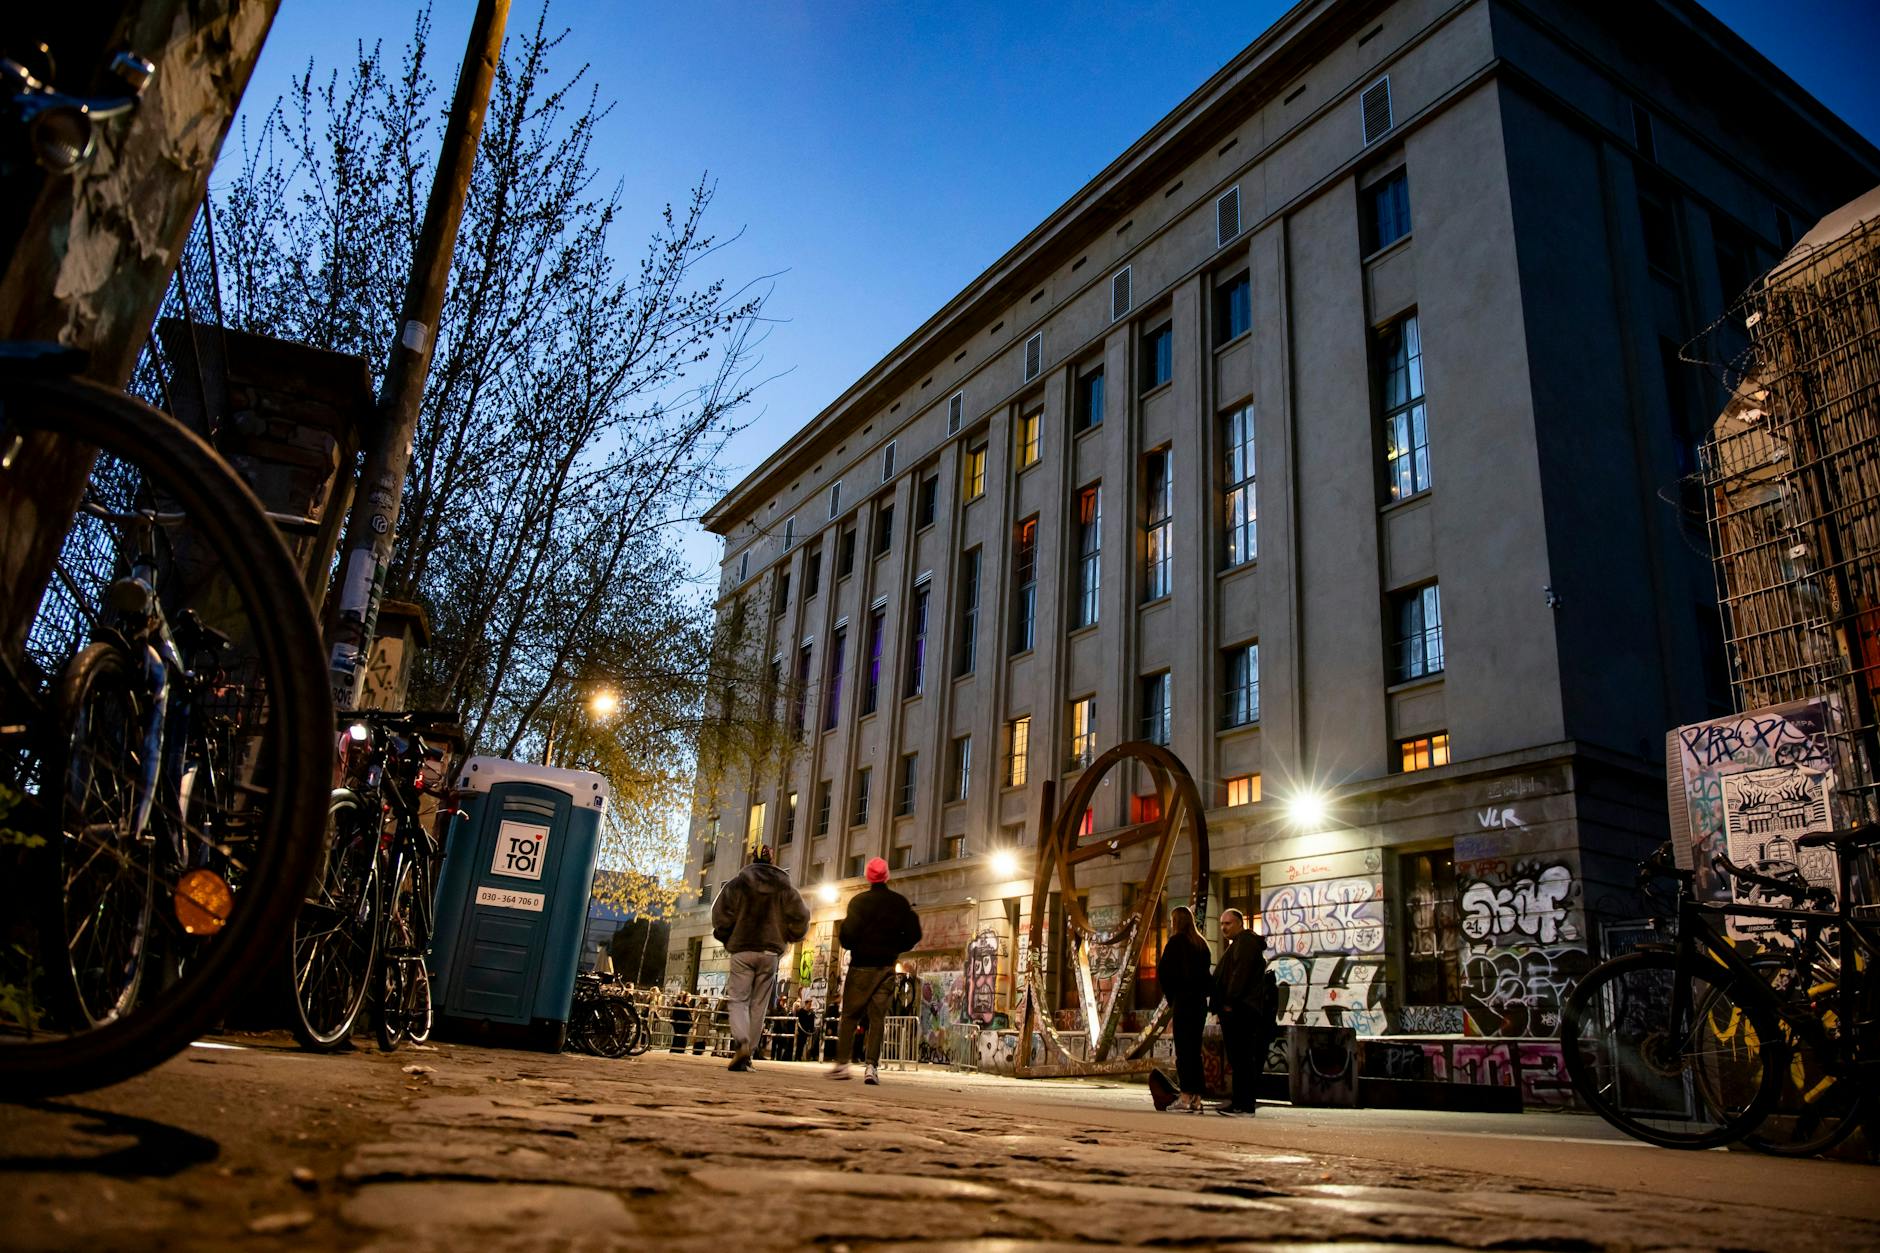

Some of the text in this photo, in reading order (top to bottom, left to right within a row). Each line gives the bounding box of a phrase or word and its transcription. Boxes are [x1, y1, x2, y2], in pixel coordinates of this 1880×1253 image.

[509, 836, 541, 856] TOI
[506, 853, 537, 872] TOI
[481, 891, 497, 902] 030
[501, 893, 516, 904] 364
[518, 896, 532, 906] 706
[533, 898, 539, 907] 0
